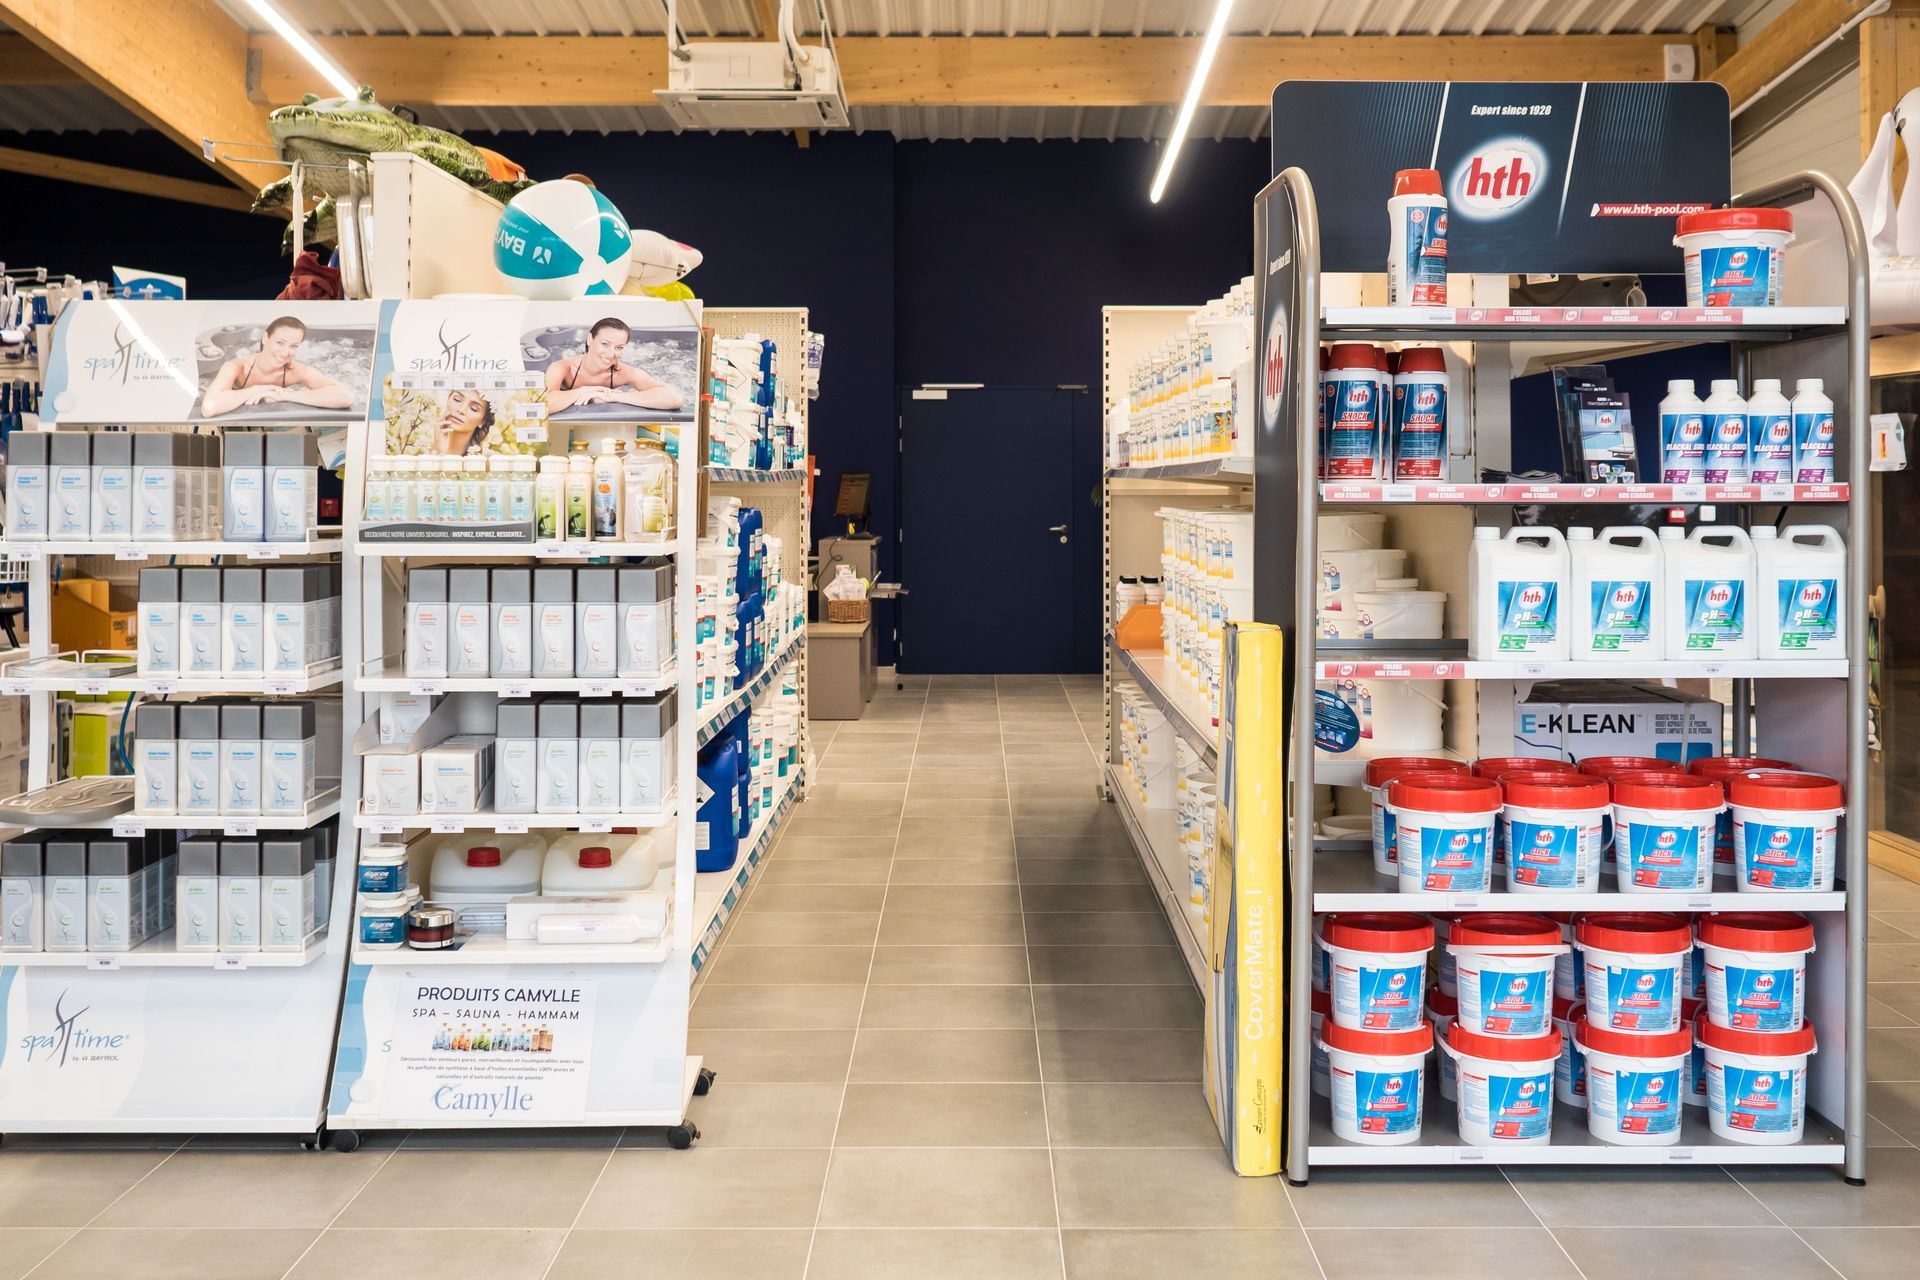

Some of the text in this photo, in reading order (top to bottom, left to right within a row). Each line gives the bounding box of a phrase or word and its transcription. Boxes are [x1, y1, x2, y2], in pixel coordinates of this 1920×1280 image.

[1471, 105, 1552, 116] Expert since 1928
[1466, 157, 1532, 200] hth
[1603, 203, 1705, 217] www.hth-pool.com
[1730, 253, 1747, 265] hth
[459, 352, 509, 372] time
[1266, 335, 1283, 400] hth
[83, 357, 115, 381] spa
[1349, 389, 1369, 403] hth
[1417, 393, 1437, 405] hth
[1342, 411, 1369, 421] SHOCK
[1410, 414, 1437, 423] SHOCK
[1685, 422, 1701, 436] hth
[1723, 422, 1742, 435] hth
[1523, 591, 1542, 603] hth
[1616, 590, 1635, 603] hth
[1709, 589, 1729, 602] hth
[1803, 588, 1822, 601] hth
[1521, 713, 1635, 734] E-KLEAN
[1450, 836, 1468, 847] hth
[1536, 832, 1553, 842] hth
[1658, 833, 1675, 843] hth
[1772, 832, 1789, 844] hth
[1244, 904, 1263, 1041] CoverMate
[1389, 976, 1406, 987] hth
[1510, 979, 1527, 991] hth
[1637, 976, 1654, 987] hth
[1756, 977, 1773, 988] hth
[417, 987, 581, 1003] PRODUITS CAMYLLE
[412, 1008, 580, 1020] SPA SAUNA HAMMAM
[20, 1029, 124, 1063] spa time
[1386, 1079, 1402, 1090] hth
[1520, 1083, 1535, 1095] hth
[1646, 1079, 1663, 1090] hth
[1754, 1078, 1771, 1089] hth
[433, 1083, 534, 1117] Camylle
